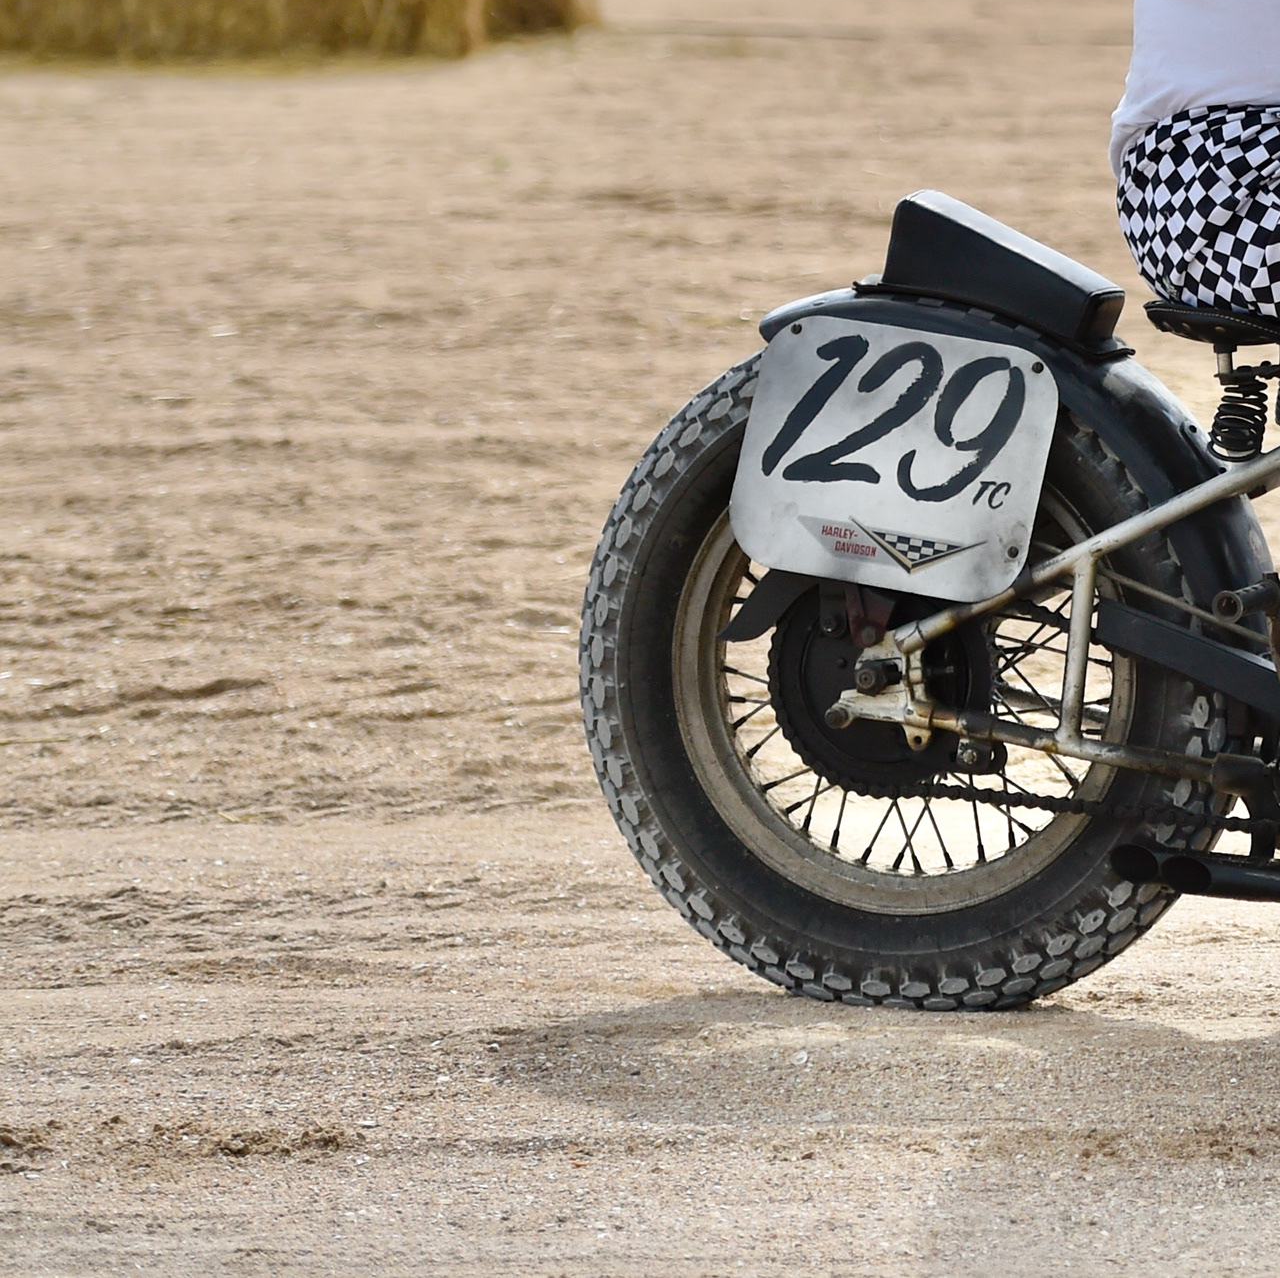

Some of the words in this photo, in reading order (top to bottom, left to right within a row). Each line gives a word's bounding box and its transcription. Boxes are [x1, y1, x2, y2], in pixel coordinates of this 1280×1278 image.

[762, 334, 1026, 502] 129
[972, 481, 1011, 510] TC
[821, 524, 858, 540] HARLEY-
[834, 540, 877, 558] DAVIDSON
